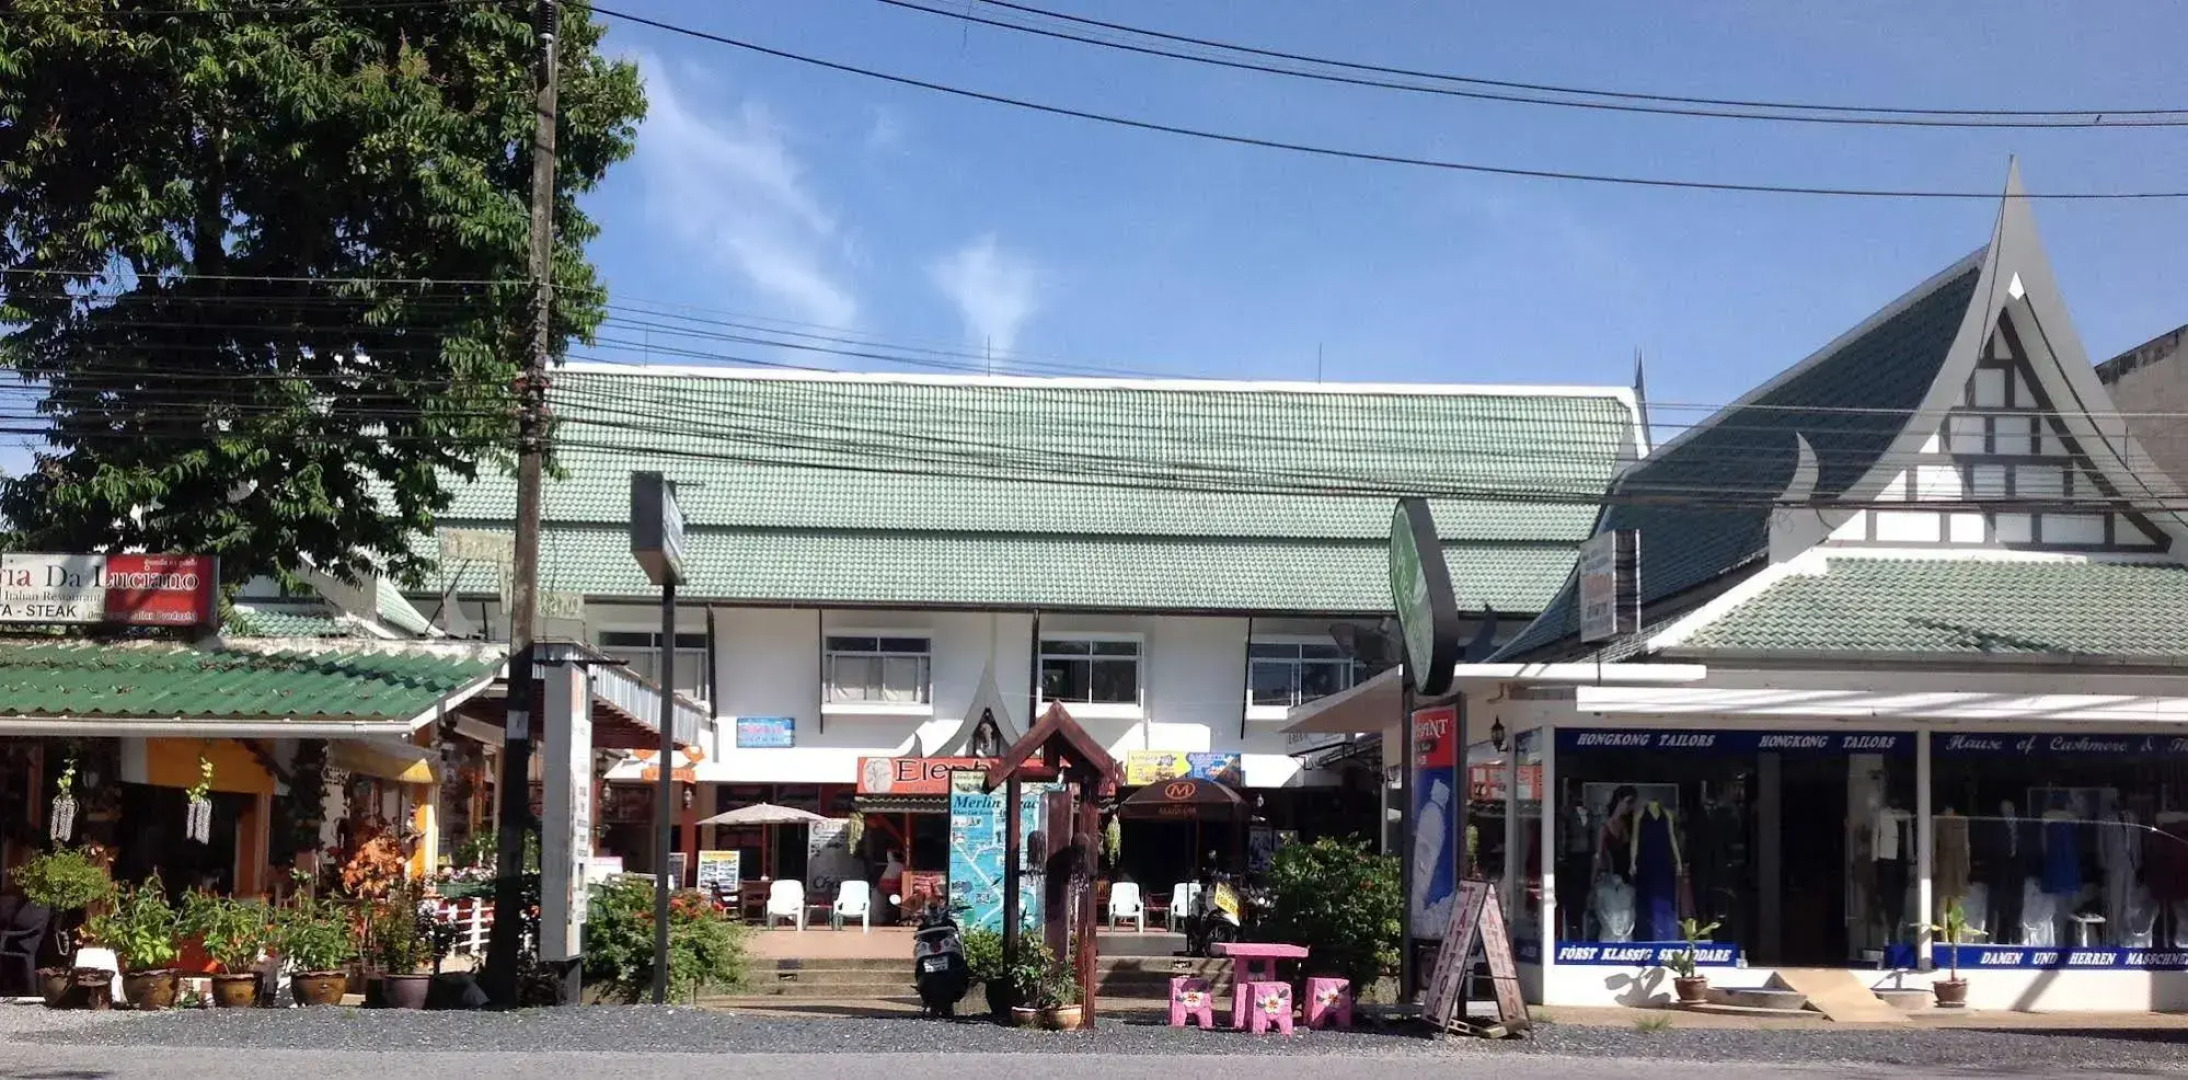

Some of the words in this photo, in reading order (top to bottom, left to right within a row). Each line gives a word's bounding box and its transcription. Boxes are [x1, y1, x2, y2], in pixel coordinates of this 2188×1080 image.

[46, 564, 82, 587] Da
[93, 564, 199, 591] Luciano
[26, 604, 77, 617] STEAK
[1577, 733, 1650, 746] HONGKONG
[1658, 734, 1716, 747] TAILORS
[1758, 735, 1829, 748] HONGKONG
[1842, 736, 1896, 749] TAILORS
[2016, 738, 2036, 754] of
[954, 795, 1001, 809] Merlin
[1981, 952, 2024, 964] DAMEN
[2033, 952, 2059, 964] UND
[2069, 952, 2117, 965] HERREN
